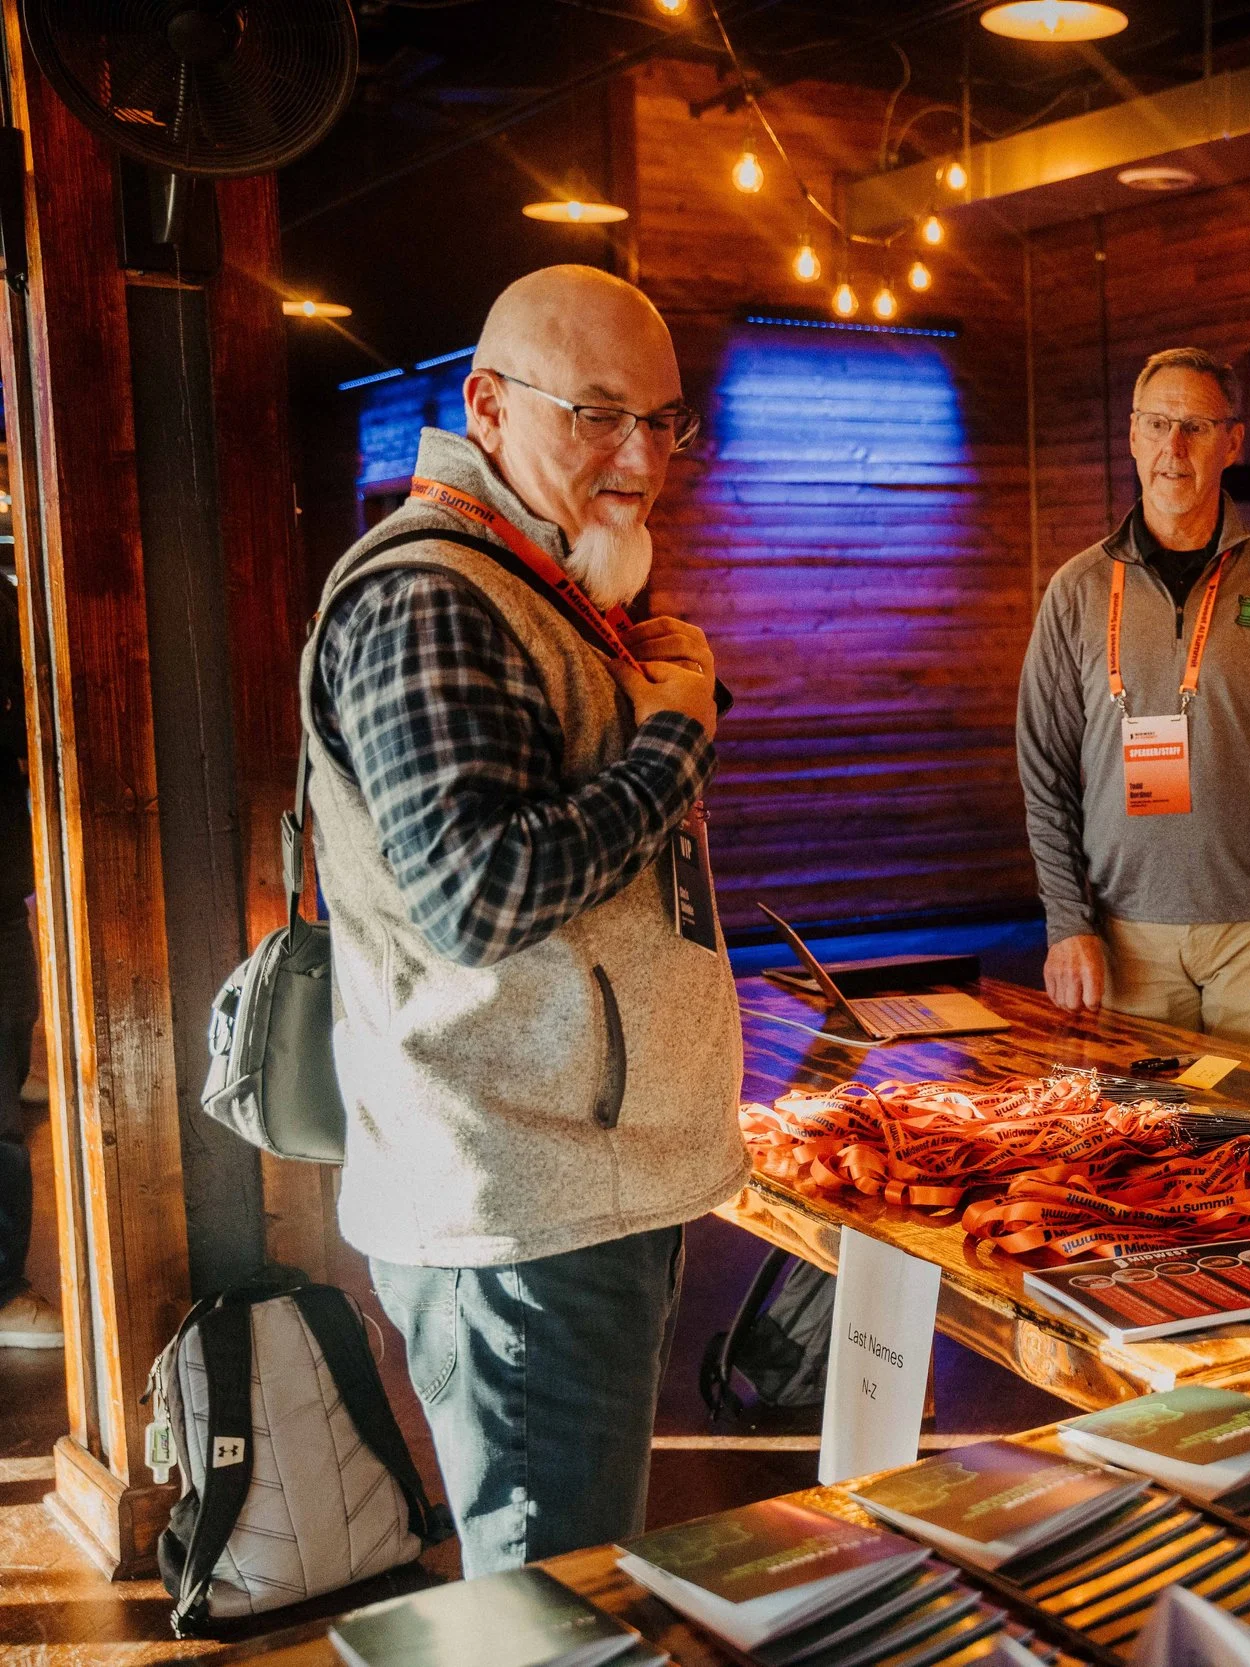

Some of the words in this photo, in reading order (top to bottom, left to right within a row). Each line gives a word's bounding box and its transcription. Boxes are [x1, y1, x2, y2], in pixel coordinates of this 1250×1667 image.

[427, 487, 439, 499] AI
[439, 490, 496, 523] Summit
[826, 1100, 871, 1122] Midwest
[1003, 1127, 1040, 1140] Midwes
[1066, 1193, 1116, 1217] Summit
[1118, 1208, 1130, 1218] AI
[1168, 1205, 1181, 1214] AI
[1183, 1195, 1235, 1213] Summit
[1062, 1232, 1115, 1254] Summit
[1127, 1249, 1189, 1263] MIDWEST
[848, 1322, 867, 1350] Last
[868, 1337, 904, 1369] Names
[862, 1377, 877, 1400] N-Z
